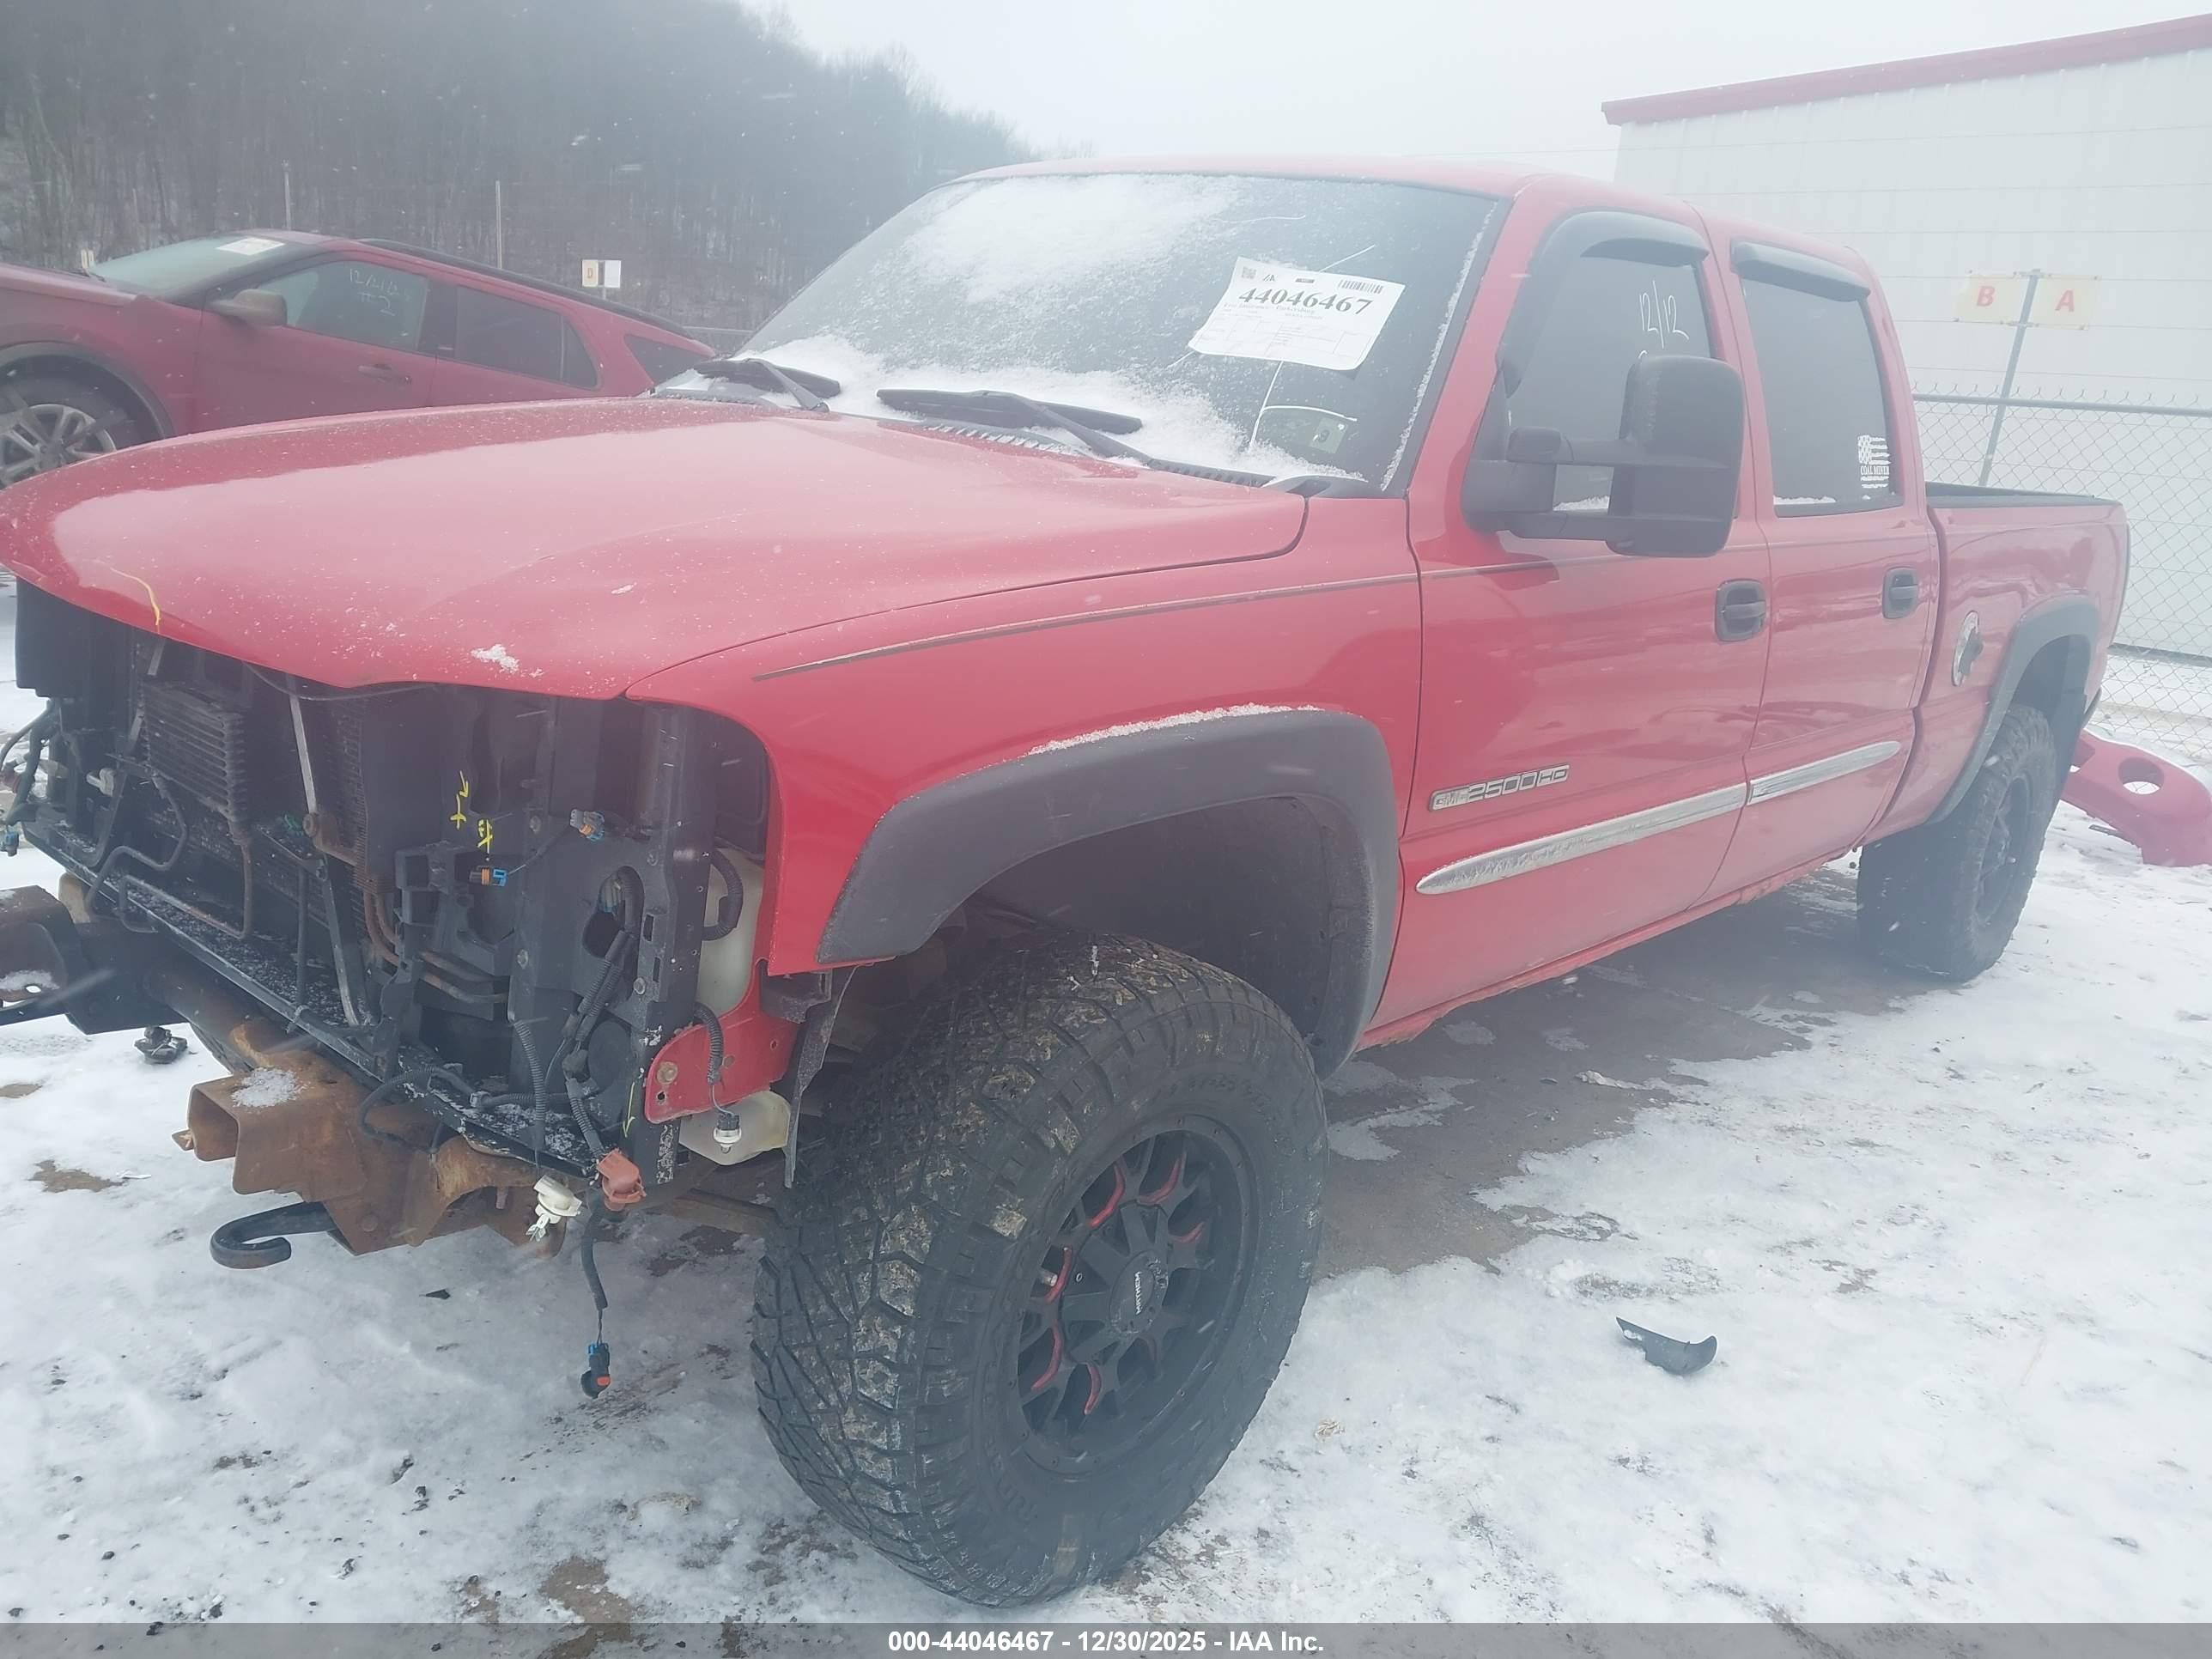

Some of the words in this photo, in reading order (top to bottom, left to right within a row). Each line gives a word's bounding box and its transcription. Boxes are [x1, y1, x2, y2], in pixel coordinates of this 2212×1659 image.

[1239, 289, 1374, 314] 44046467
[1977, 285, 1996, 307] B
[2055, 289, 2075, 313] A
[1638, 280, 1690, 349] 12/12
